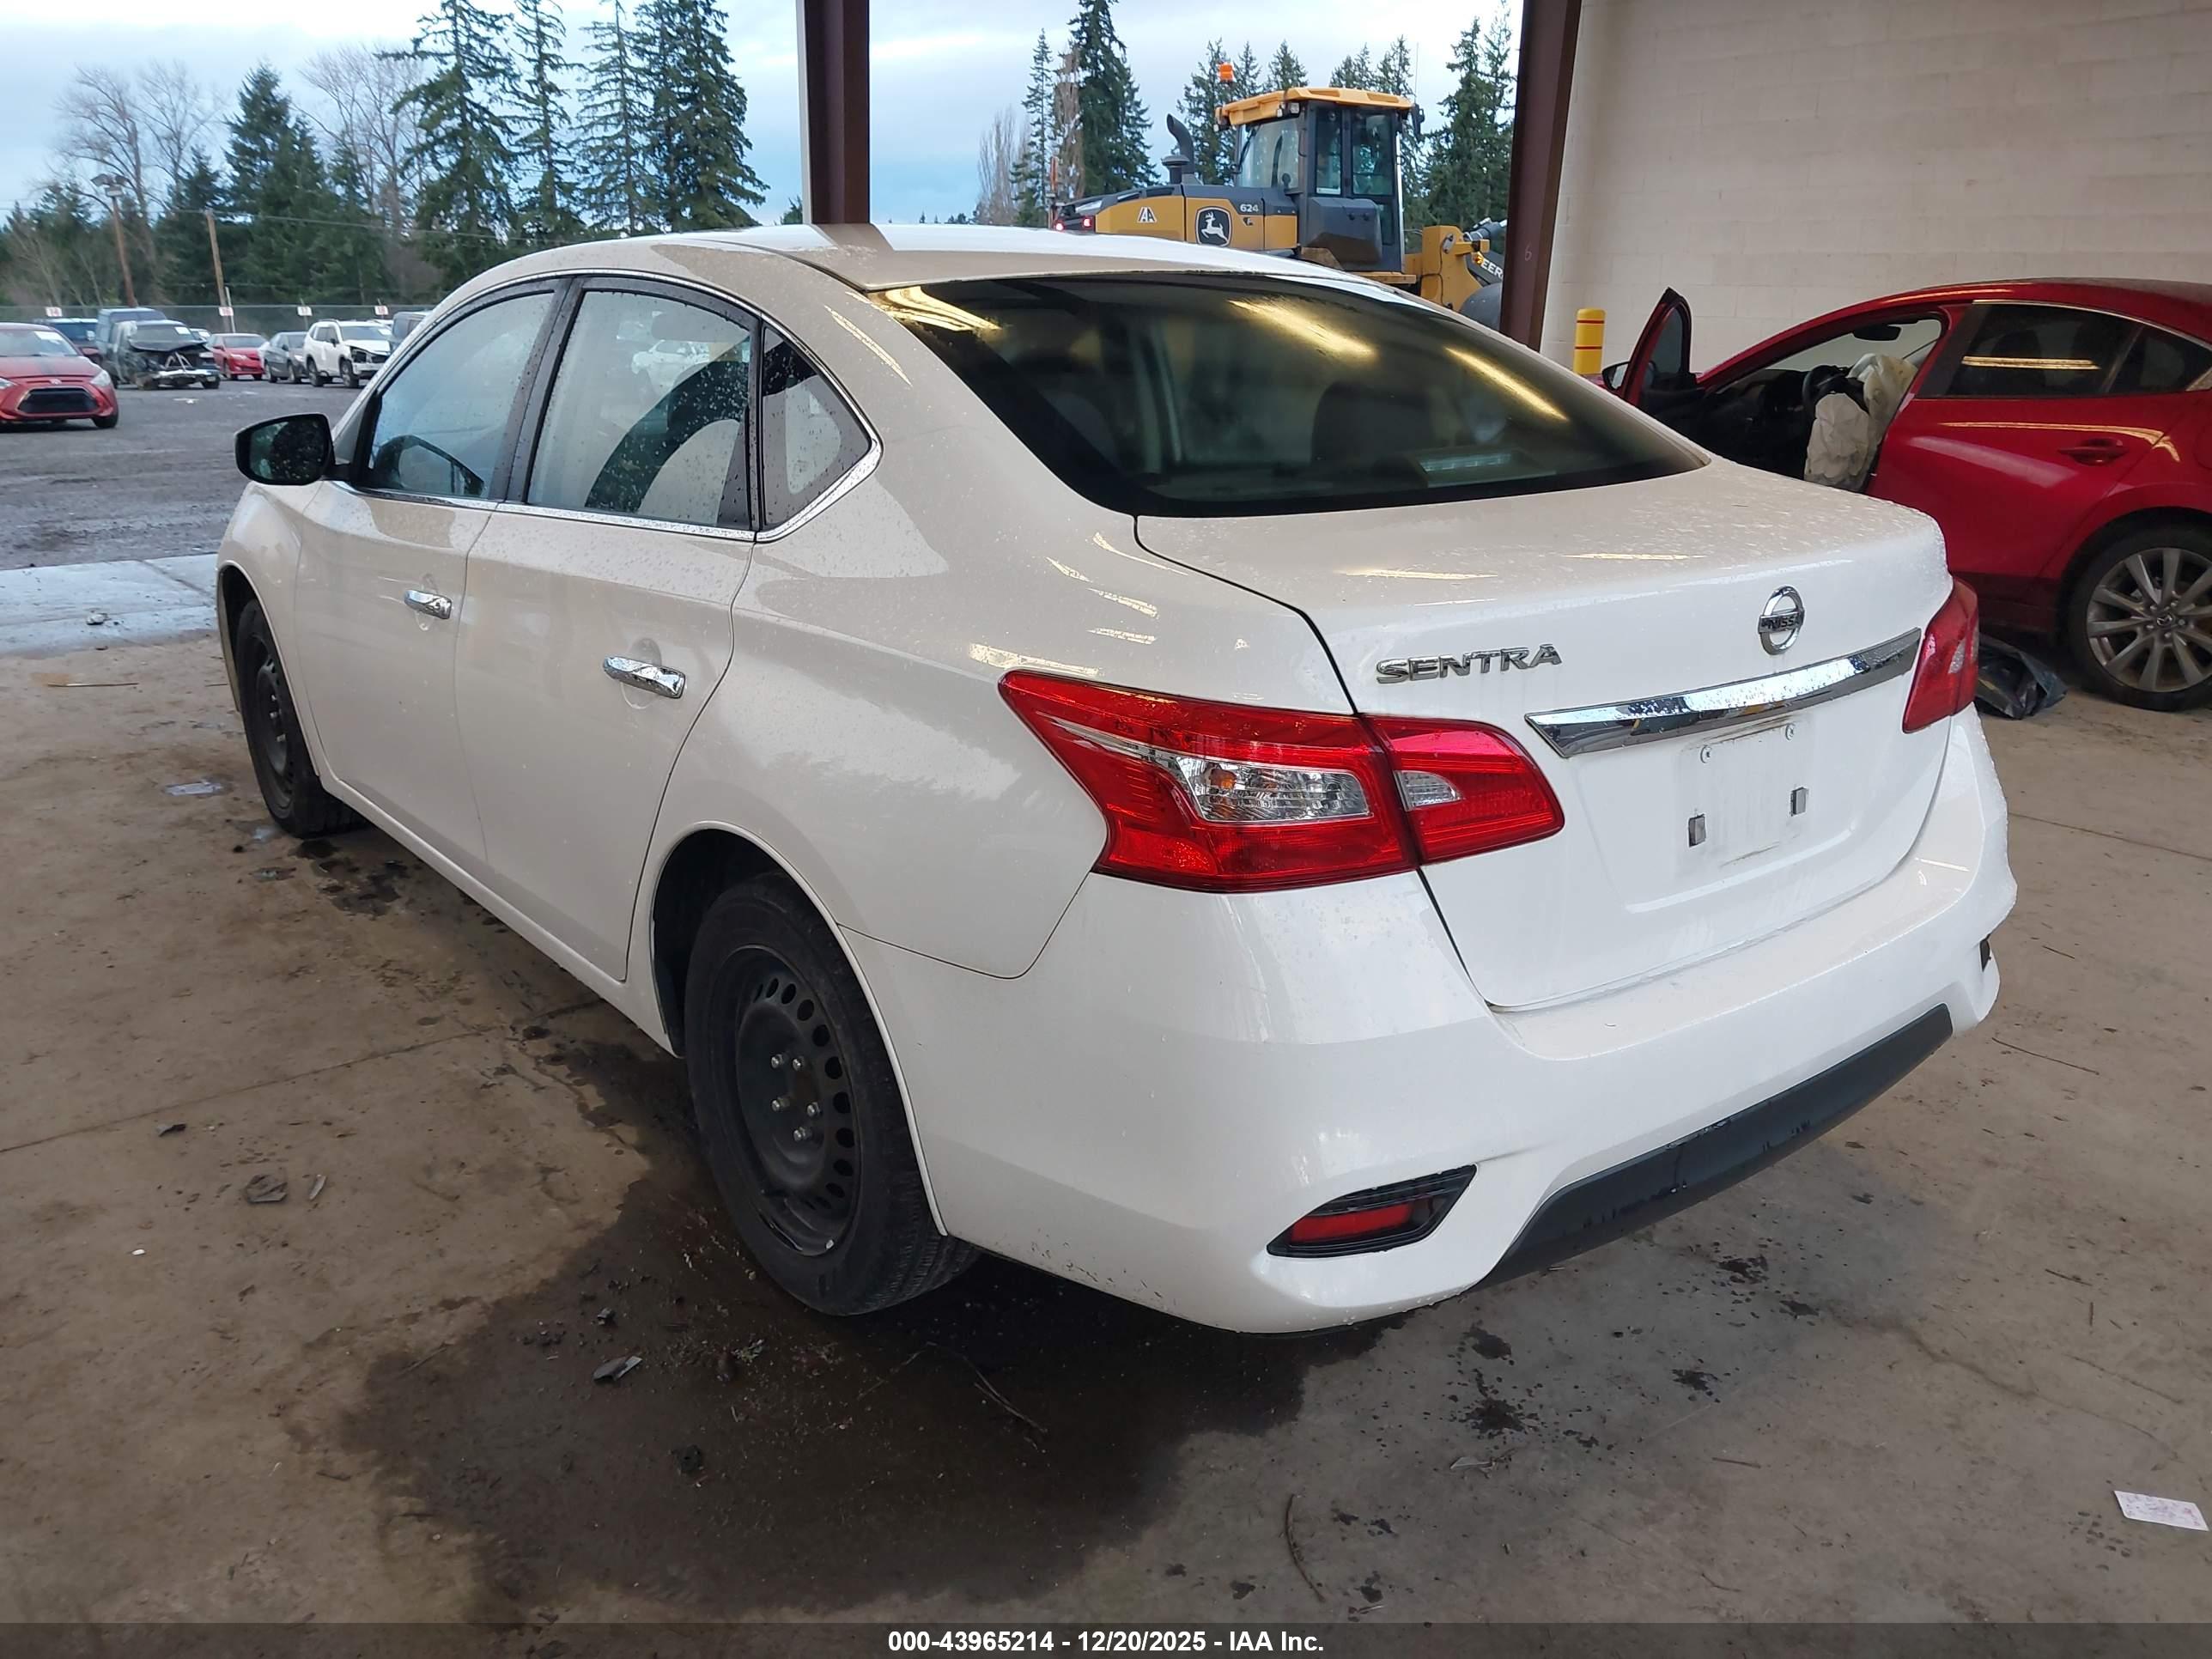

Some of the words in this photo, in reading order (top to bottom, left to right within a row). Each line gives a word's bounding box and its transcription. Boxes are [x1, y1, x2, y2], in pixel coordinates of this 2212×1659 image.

[1239, 204, 1259, 212] 624
[1524, 243, 1533, 262] 6
[1376, 644, 1562, 684] SENTRA
